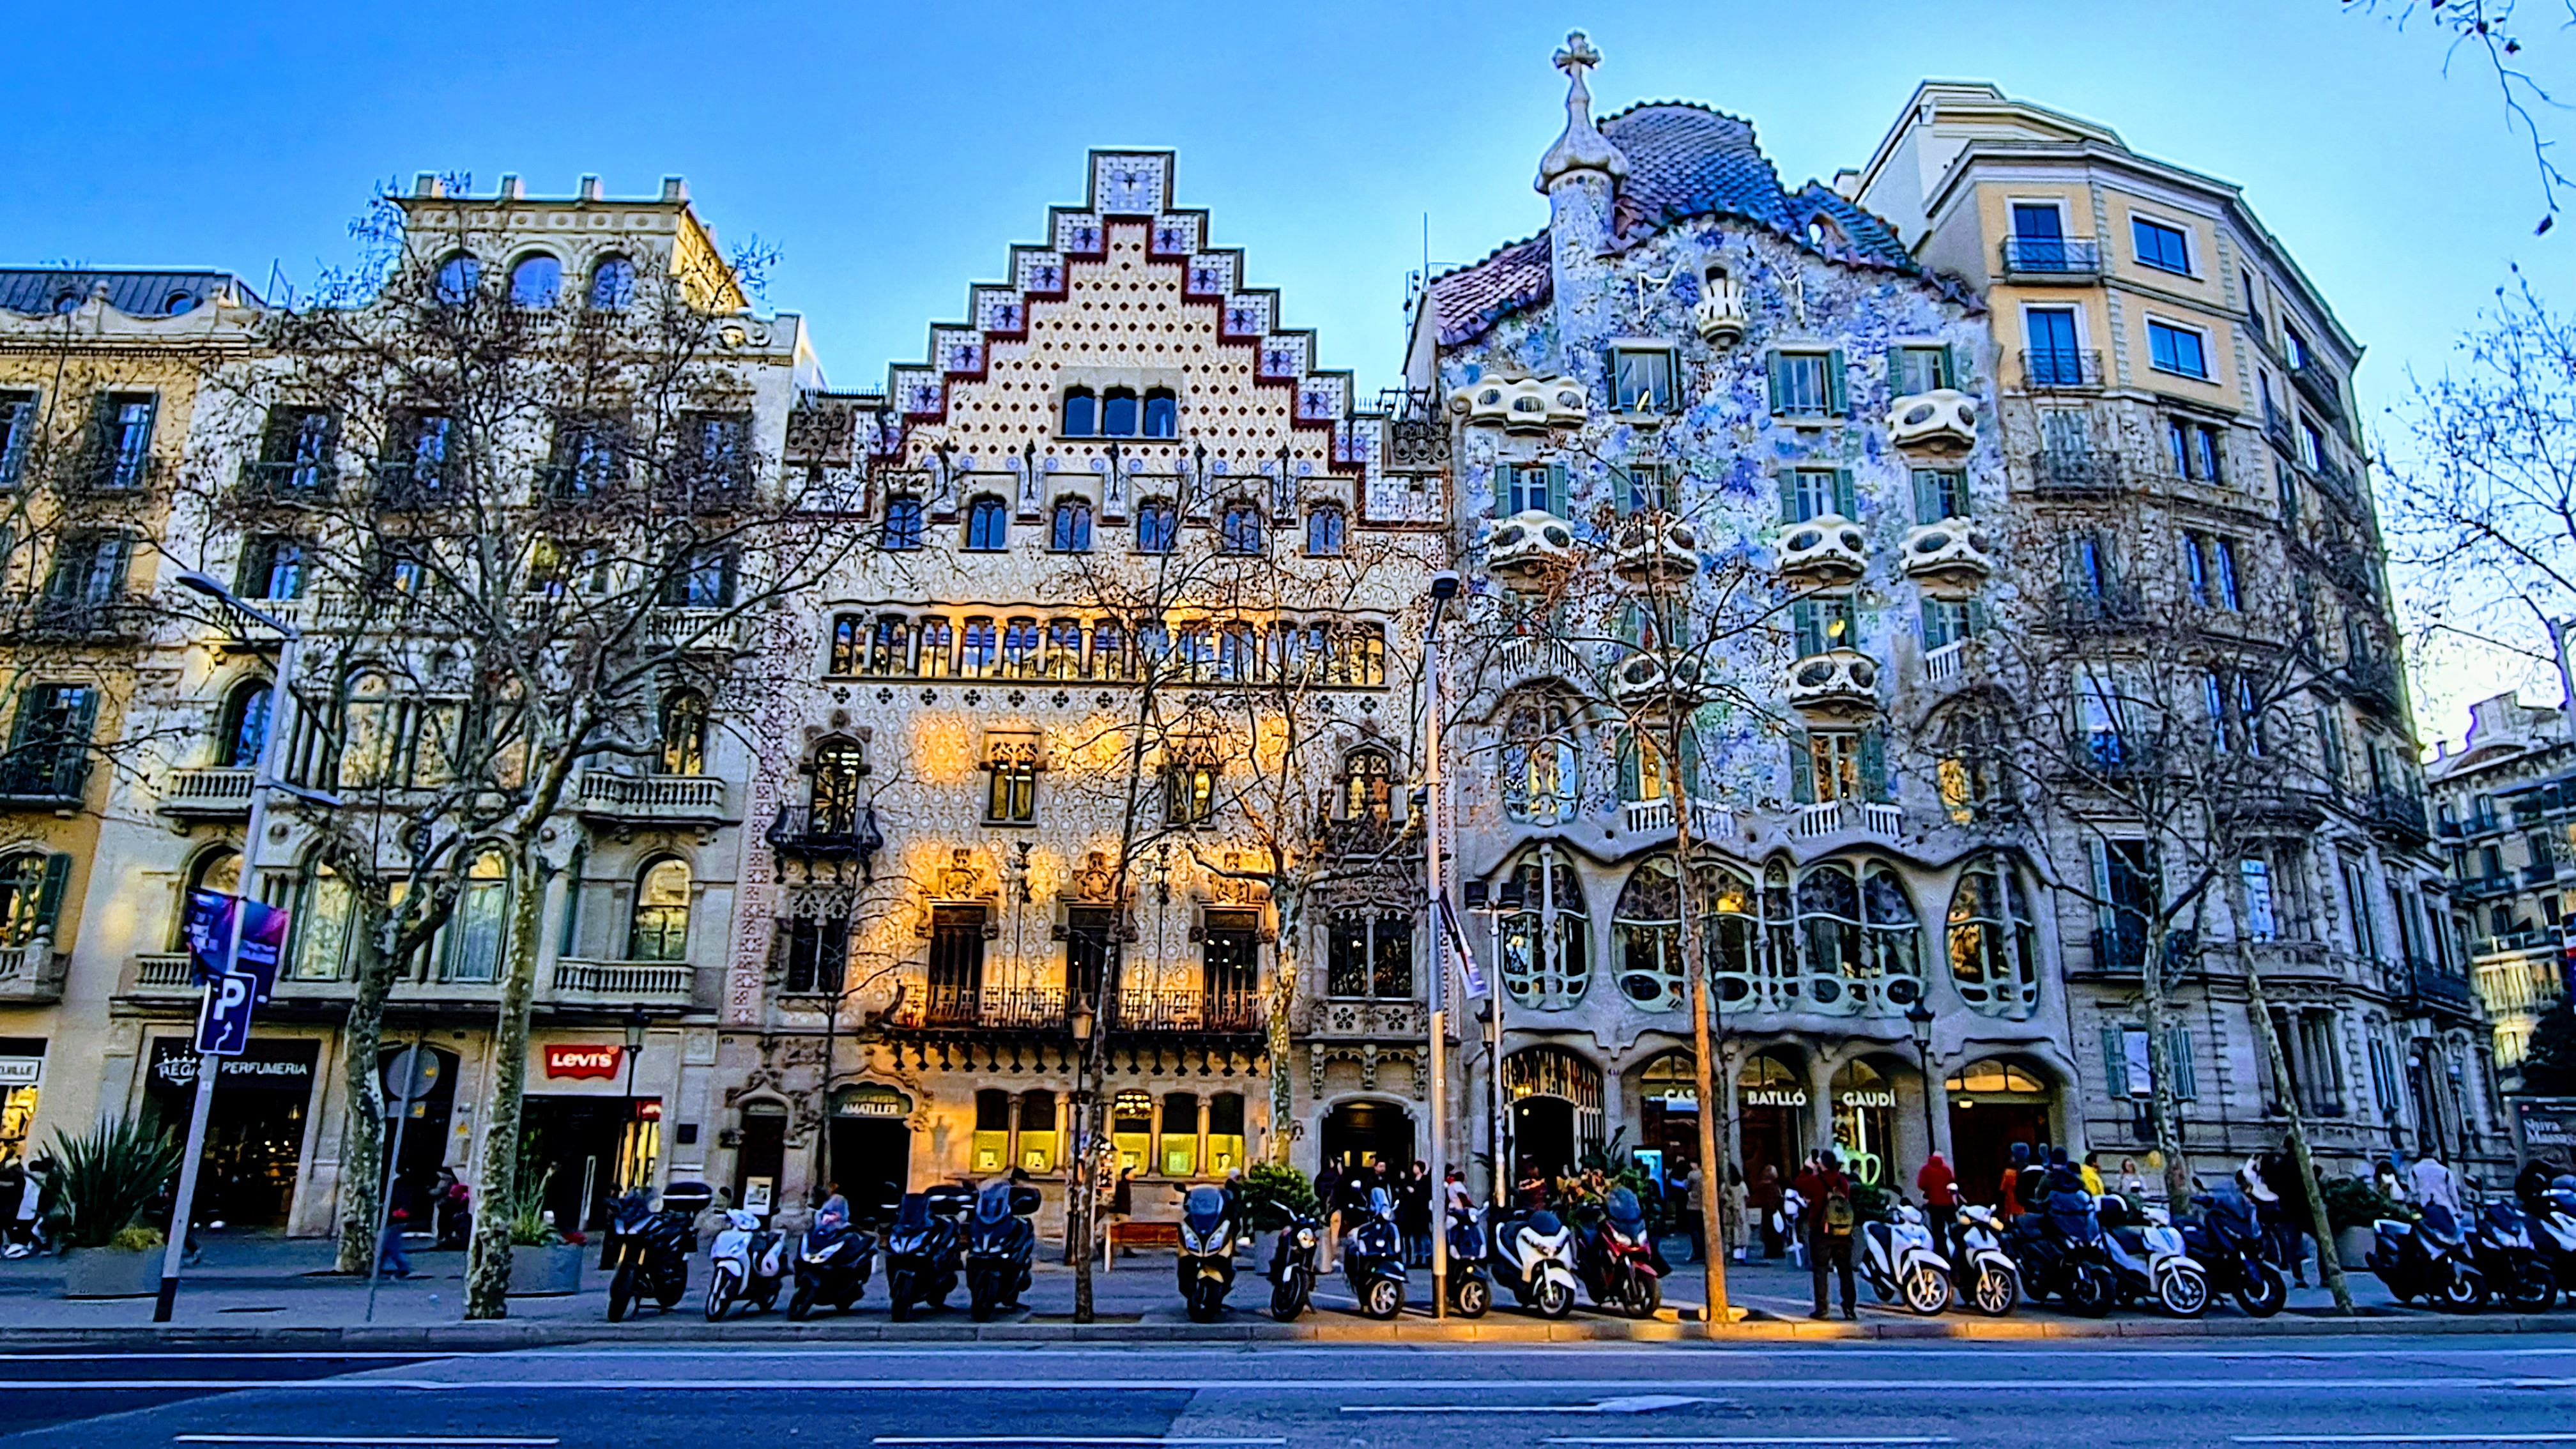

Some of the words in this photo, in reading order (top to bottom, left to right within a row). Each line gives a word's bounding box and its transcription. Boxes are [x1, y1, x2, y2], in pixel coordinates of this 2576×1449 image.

[213, 977, 246, 1020] P
[222, 1061, 307, 1075] PERFUMERIA
[1664, 1088, 1699, 1102] CAS
[1747, 1087, 1807, 1107] BATLLÓ
[1842, 1088, 1896, 1107] GAUDÍ
[840, 1103, 898, 1115] AMATLLER
